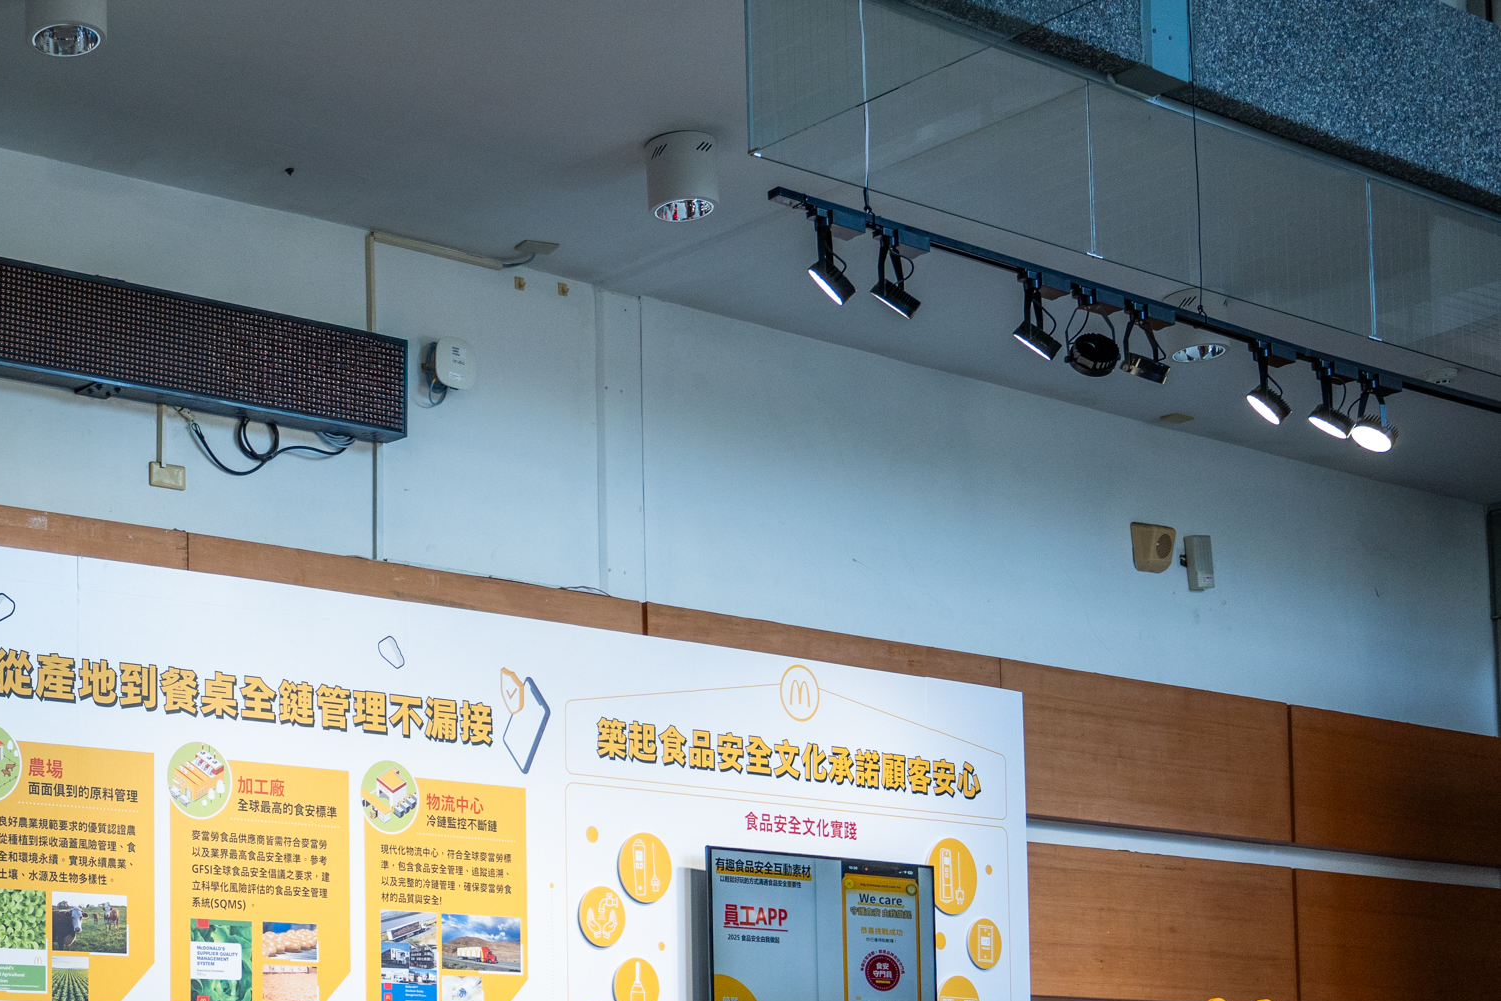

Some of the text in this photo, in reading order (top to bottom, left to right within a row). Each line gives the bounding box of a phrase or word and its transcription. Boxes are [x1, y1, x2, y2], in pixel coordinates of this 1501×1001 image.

[28, 757, 63, 779] 農場
[597, 717, 981, 800] 築起食品安全文化承諾顧客安心
[28, 781, 138, 803] 面面俱到的原料管理
[238, 776, 285, 797] 加工廠
[238, 798, 337, 818] 全球最高的食安標準
[426, 793, 483, 814] 物流中心
[426, 815, 497, 832] 冷鏈監控不斷鏈
[744, 811, 857, 841] 食品安全文化實踐
[715, 857, 811, 878] 有趣食品安全互動素材
[859, 893, 902, 906] We care
[724, 904, 788, 926] 員工APP
